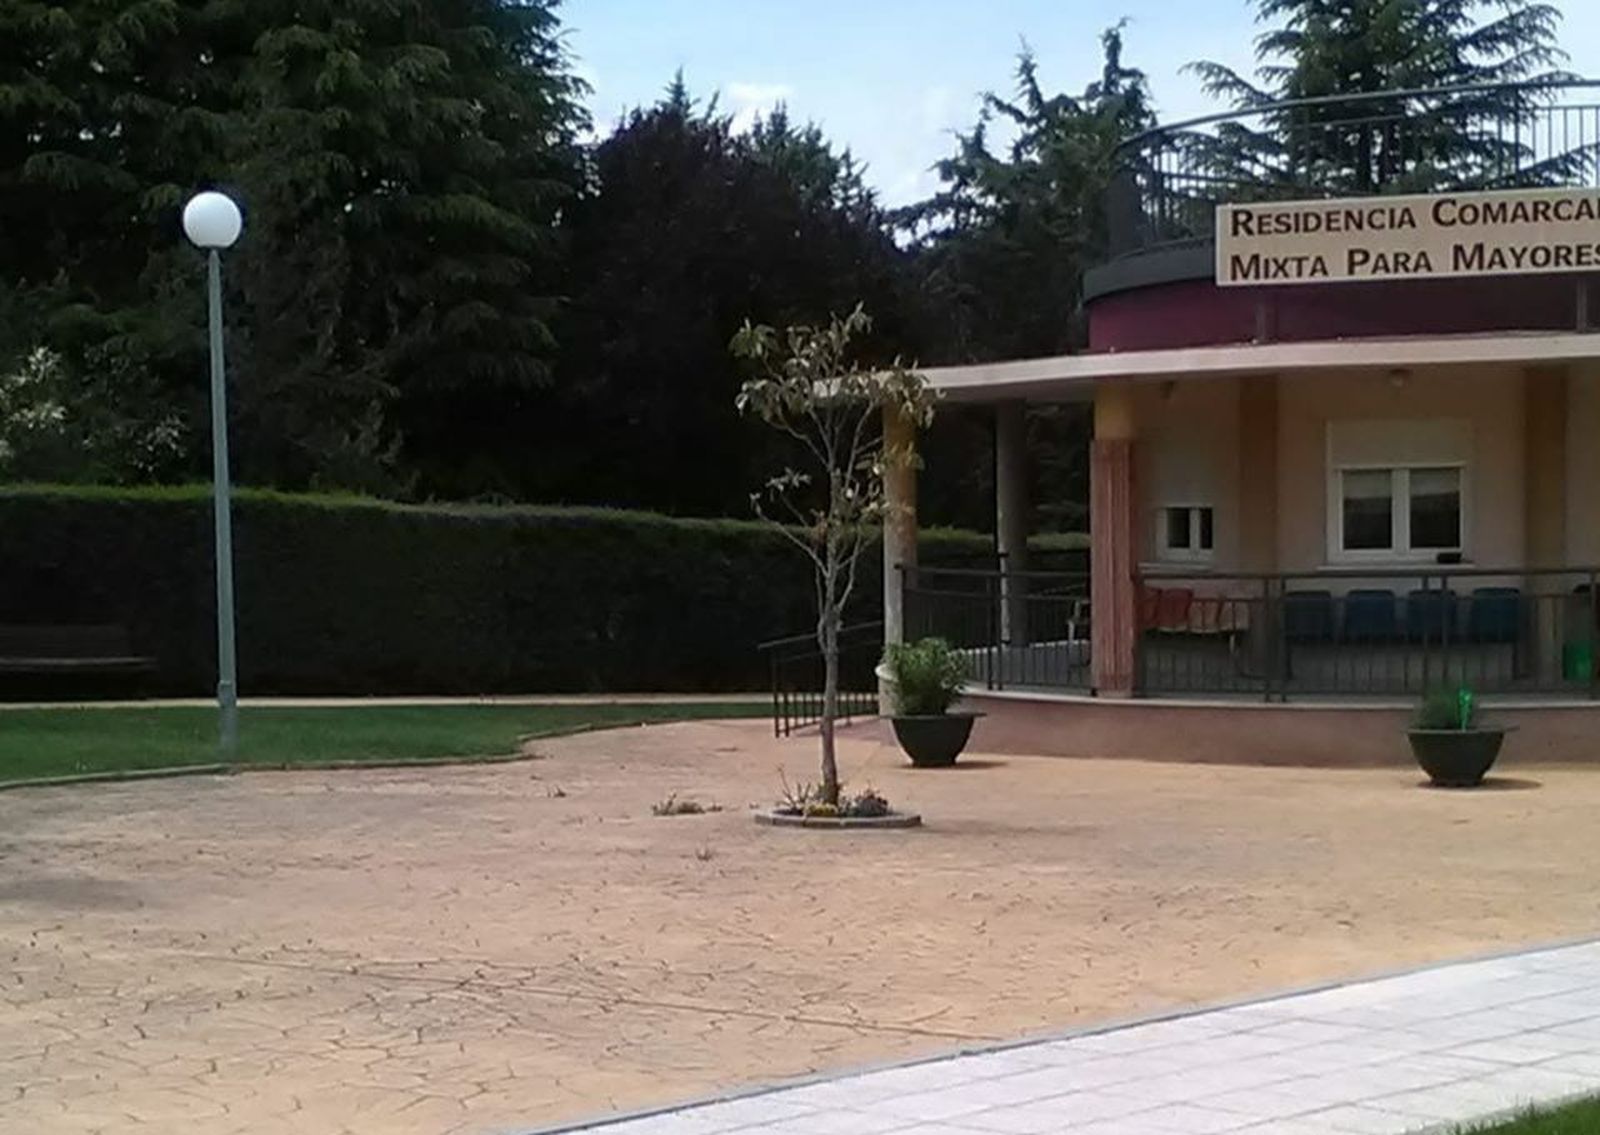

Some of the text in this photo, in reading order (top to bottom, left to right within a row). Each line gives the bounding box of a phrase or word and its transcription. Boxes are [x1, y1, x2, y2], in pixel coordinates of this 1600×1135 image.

[1231, 198, 1600, 236] RESIDENCIA COMARCA
[1230, 253, 1329, 281] MIXTA
[1347, 248, 1432, 275] PARA
